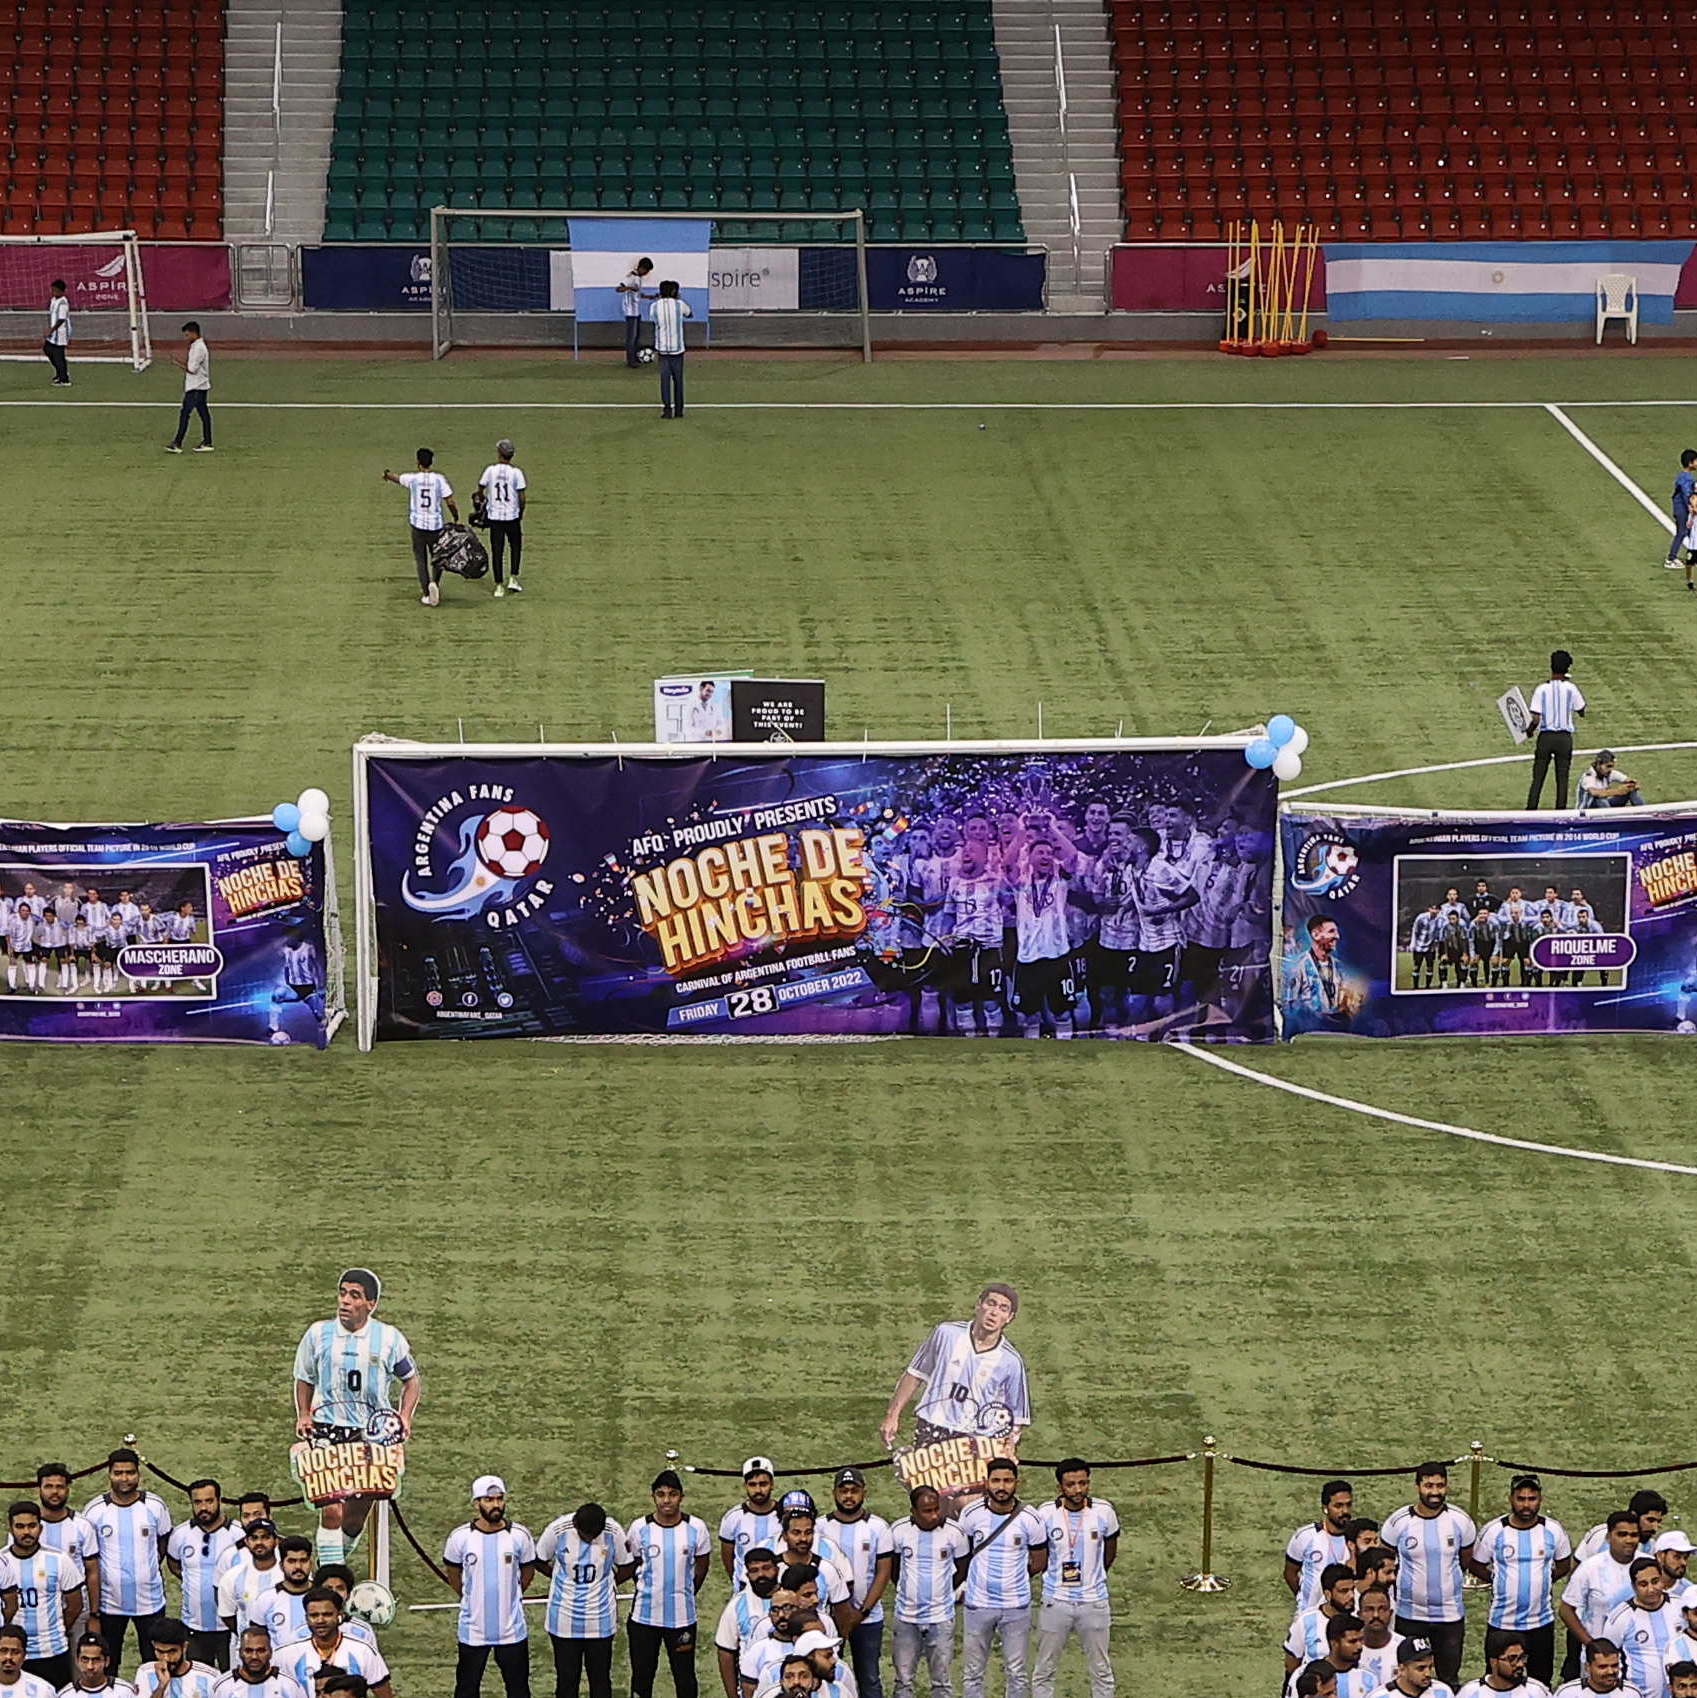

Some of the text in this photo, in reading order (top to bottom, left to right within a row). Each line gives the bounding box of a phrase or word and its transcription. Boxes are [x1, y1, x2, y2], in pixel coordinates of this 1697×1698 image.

[710, 268, 760, 289] spire
[897, 286, 947, 296] ASPIRE
[421, 488, 433, 508] 5
[494, 482, 511, 502] 11
[794, 708, 805, 716] BE
[414, 783, 515, 877] ARGENTINA FANS
[632, 796, 838, 857] AFQ PROUDLY PRESENTS
[217, 860, 303, 899] NOCHE DE
[631, 828, 870, 928] NOCHE DE
[1638, 851, 1697, 889] NOCHE
[226, 878, 304, 914] HINCHAS
[486, 879, 554, 929] QATAR
[655, 878, 866, 970] HINCHAS
[124, 949, 215, 964] MASCHERANO
[1550, 938, 1617, 955] RIQUELME
[1570, 954, 1596, 966] ZONE
[158, 963, 184, 976] ZONE
[675, 945, 857, 994] CARNIVAL OF ARGENTINA FOOTBALL FANS
[679, 971, 863, 1022] FRIDAY 28 OCTOBER 2022
[339, 1367, 362, 1392] 10
[950, 1382, 970, 1405] 10
[296, 1443, 400, 1477] NOCHE DE
[899, 1436, 976, 1480] NOCHE
[305, 1465, 399, 1499] HINCHAS
[572, 1563, 597, 1584] 10
[18, 1586, 39, 1608] 10
